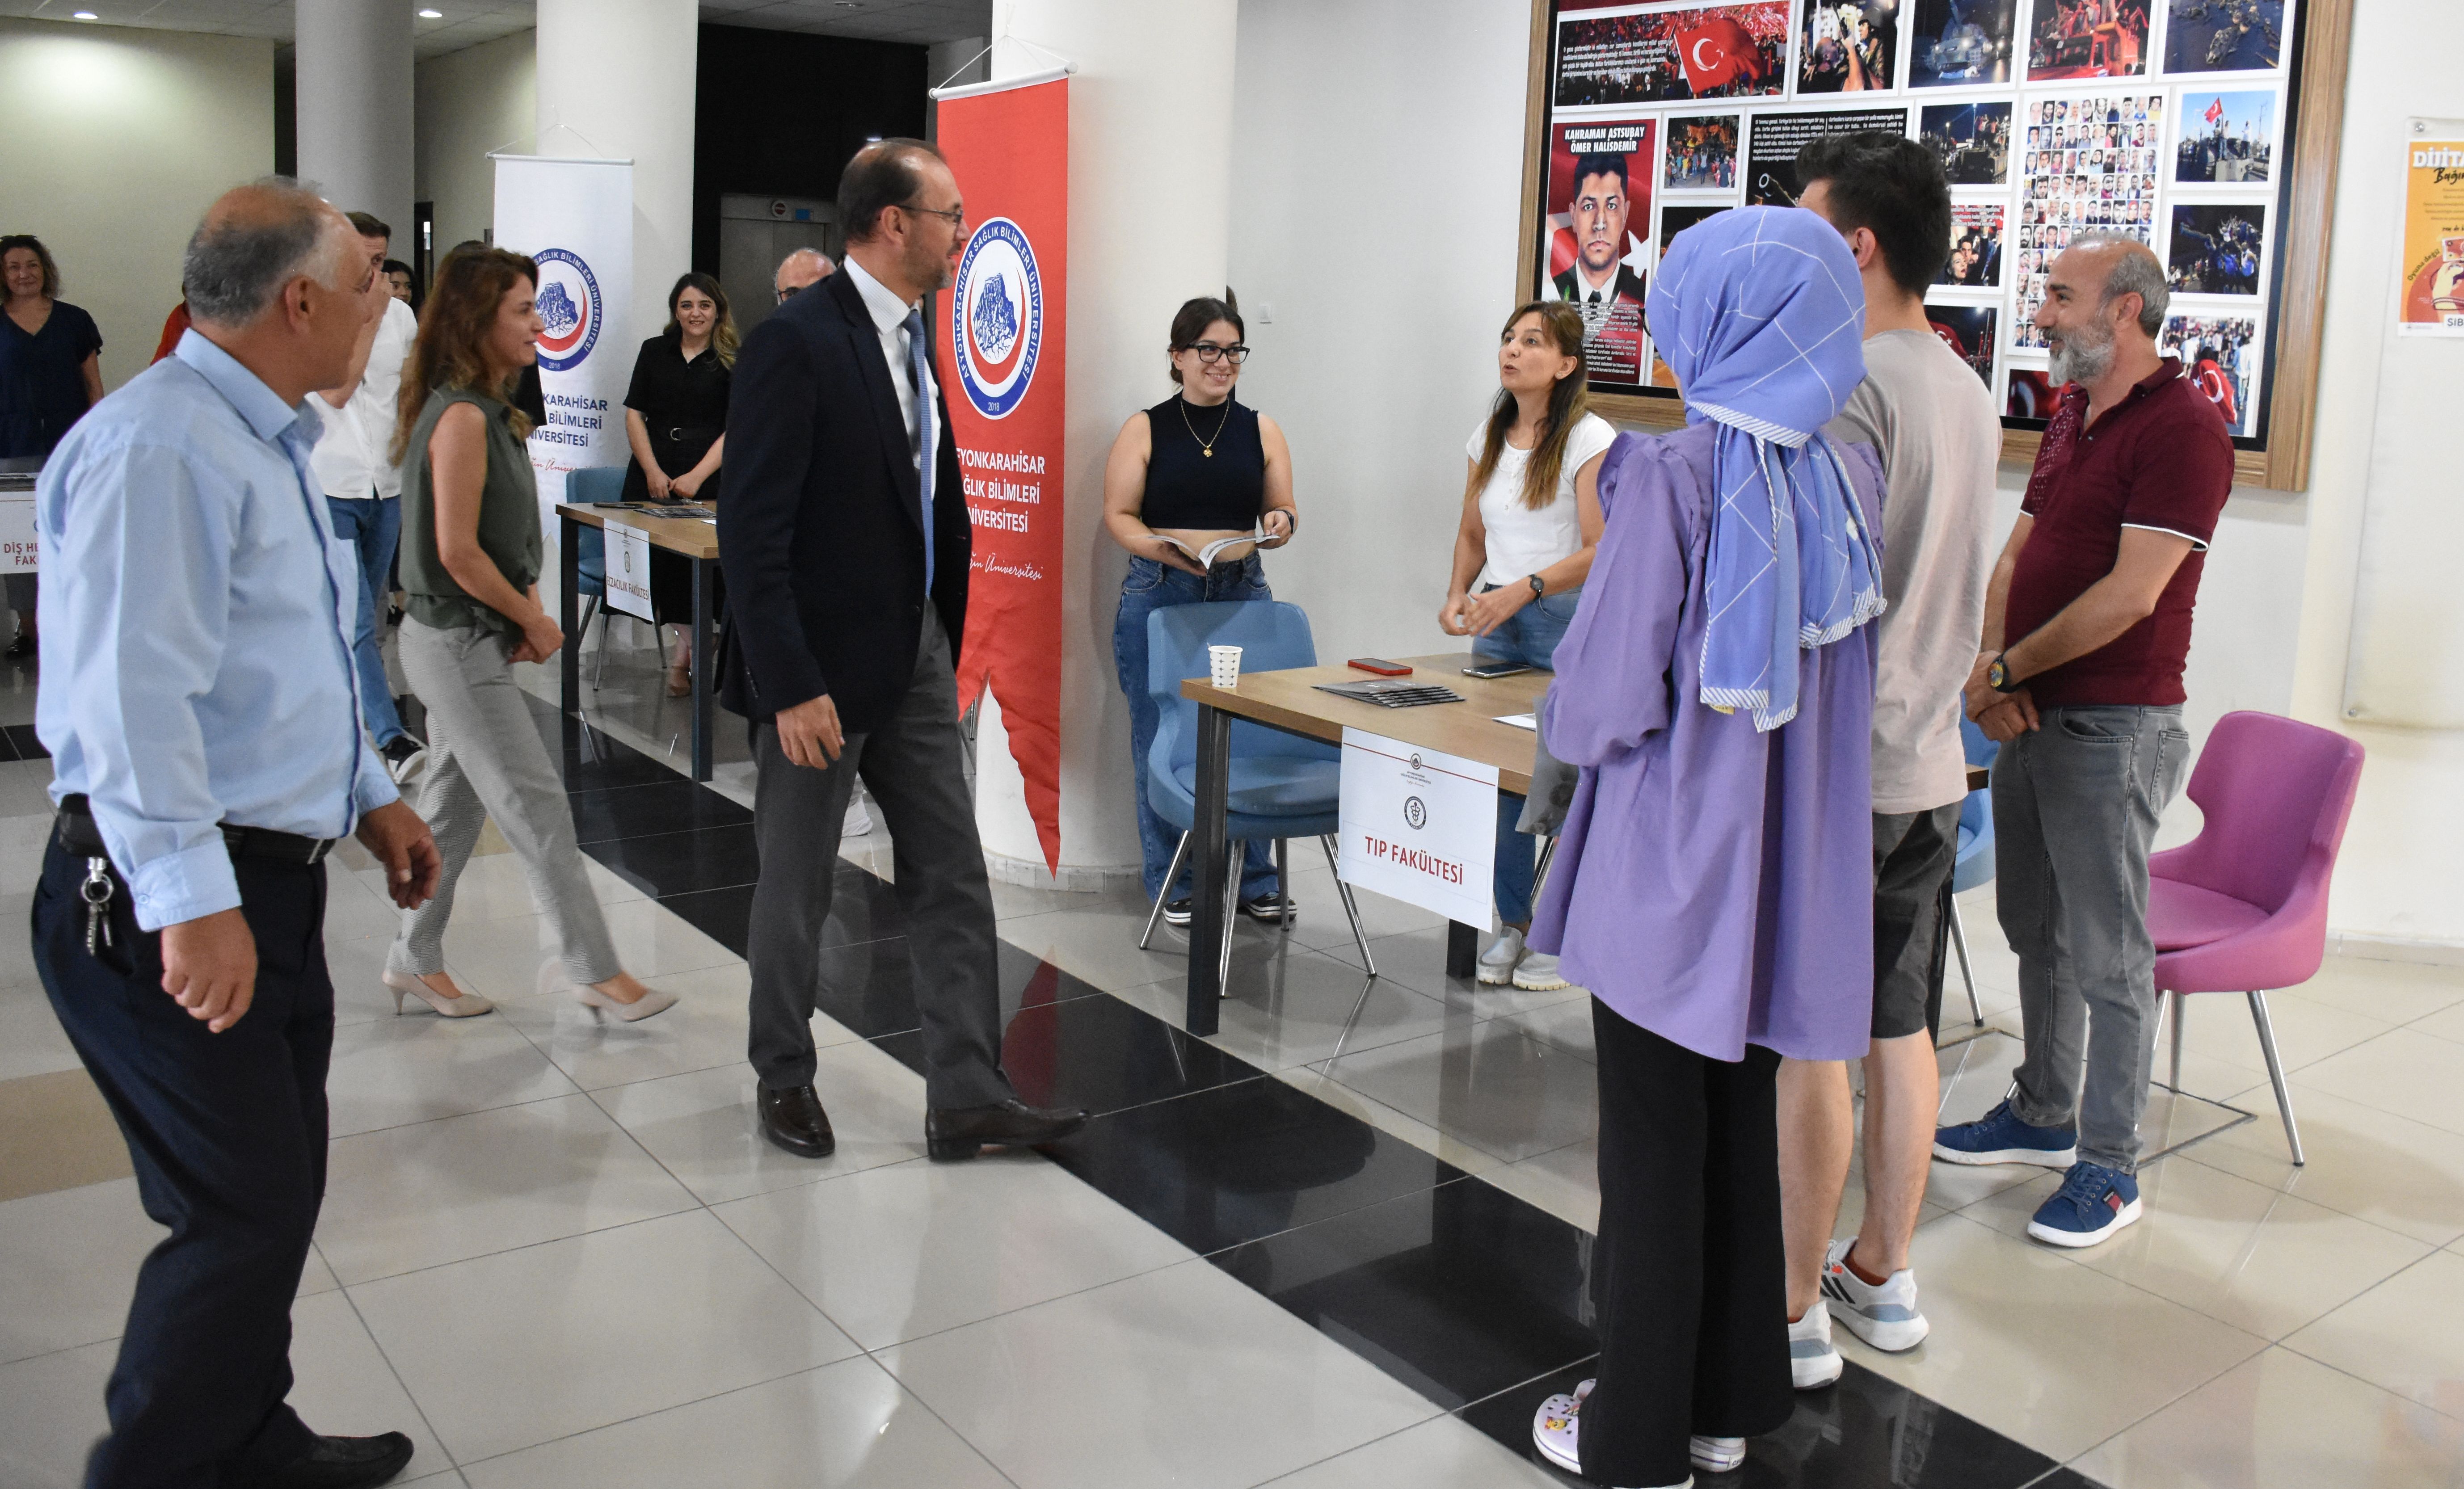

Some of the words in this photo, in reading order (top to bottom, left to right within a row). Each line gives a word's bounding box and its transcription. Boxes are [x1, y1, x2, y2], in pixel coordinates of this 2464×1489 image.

[1565, 128, 1606, 140] KAHRAMAN
[1608, 126, 1645, 139] ASTSUBAY
[1571, 140, 1592, 153] ÖMER
[1593, 137, 1637, 153] HALİSDEMİR
[988, 402, 1000, 412] 2018
[549, 411, 602, 429] BİLİMLERİ
[988, 477, 1040, 504] BİLİMLERİ
[4, 542, 23, 555] DİŞ
[15, 555, 37, 565] FAK
[985, 552, 1044, 581] Üniversitesi
[1365, 835, 1387, 858] TIP
[1392, 844, 1463, 885] FAKÜLTESİ
